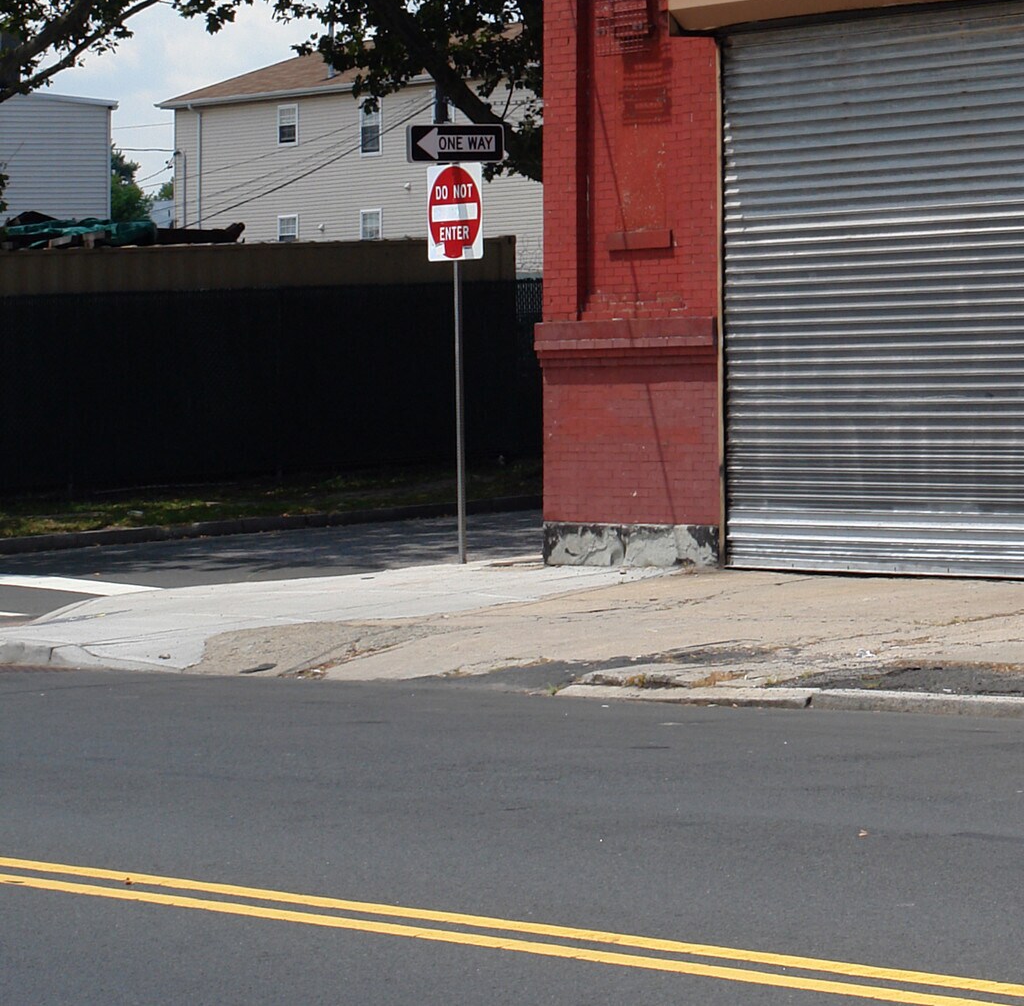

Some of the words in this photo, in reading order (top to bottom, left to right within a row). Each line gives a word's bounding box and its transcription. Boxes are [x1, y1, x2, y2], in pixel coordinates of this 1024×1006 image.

[438, 136, 463, 151] ONE
[467, 136, 494, 151] WAY
[435, 185, 448, 200] DO
[453, 183, 472, 199] NOT
[439, 225, 469, 241] ENTER
